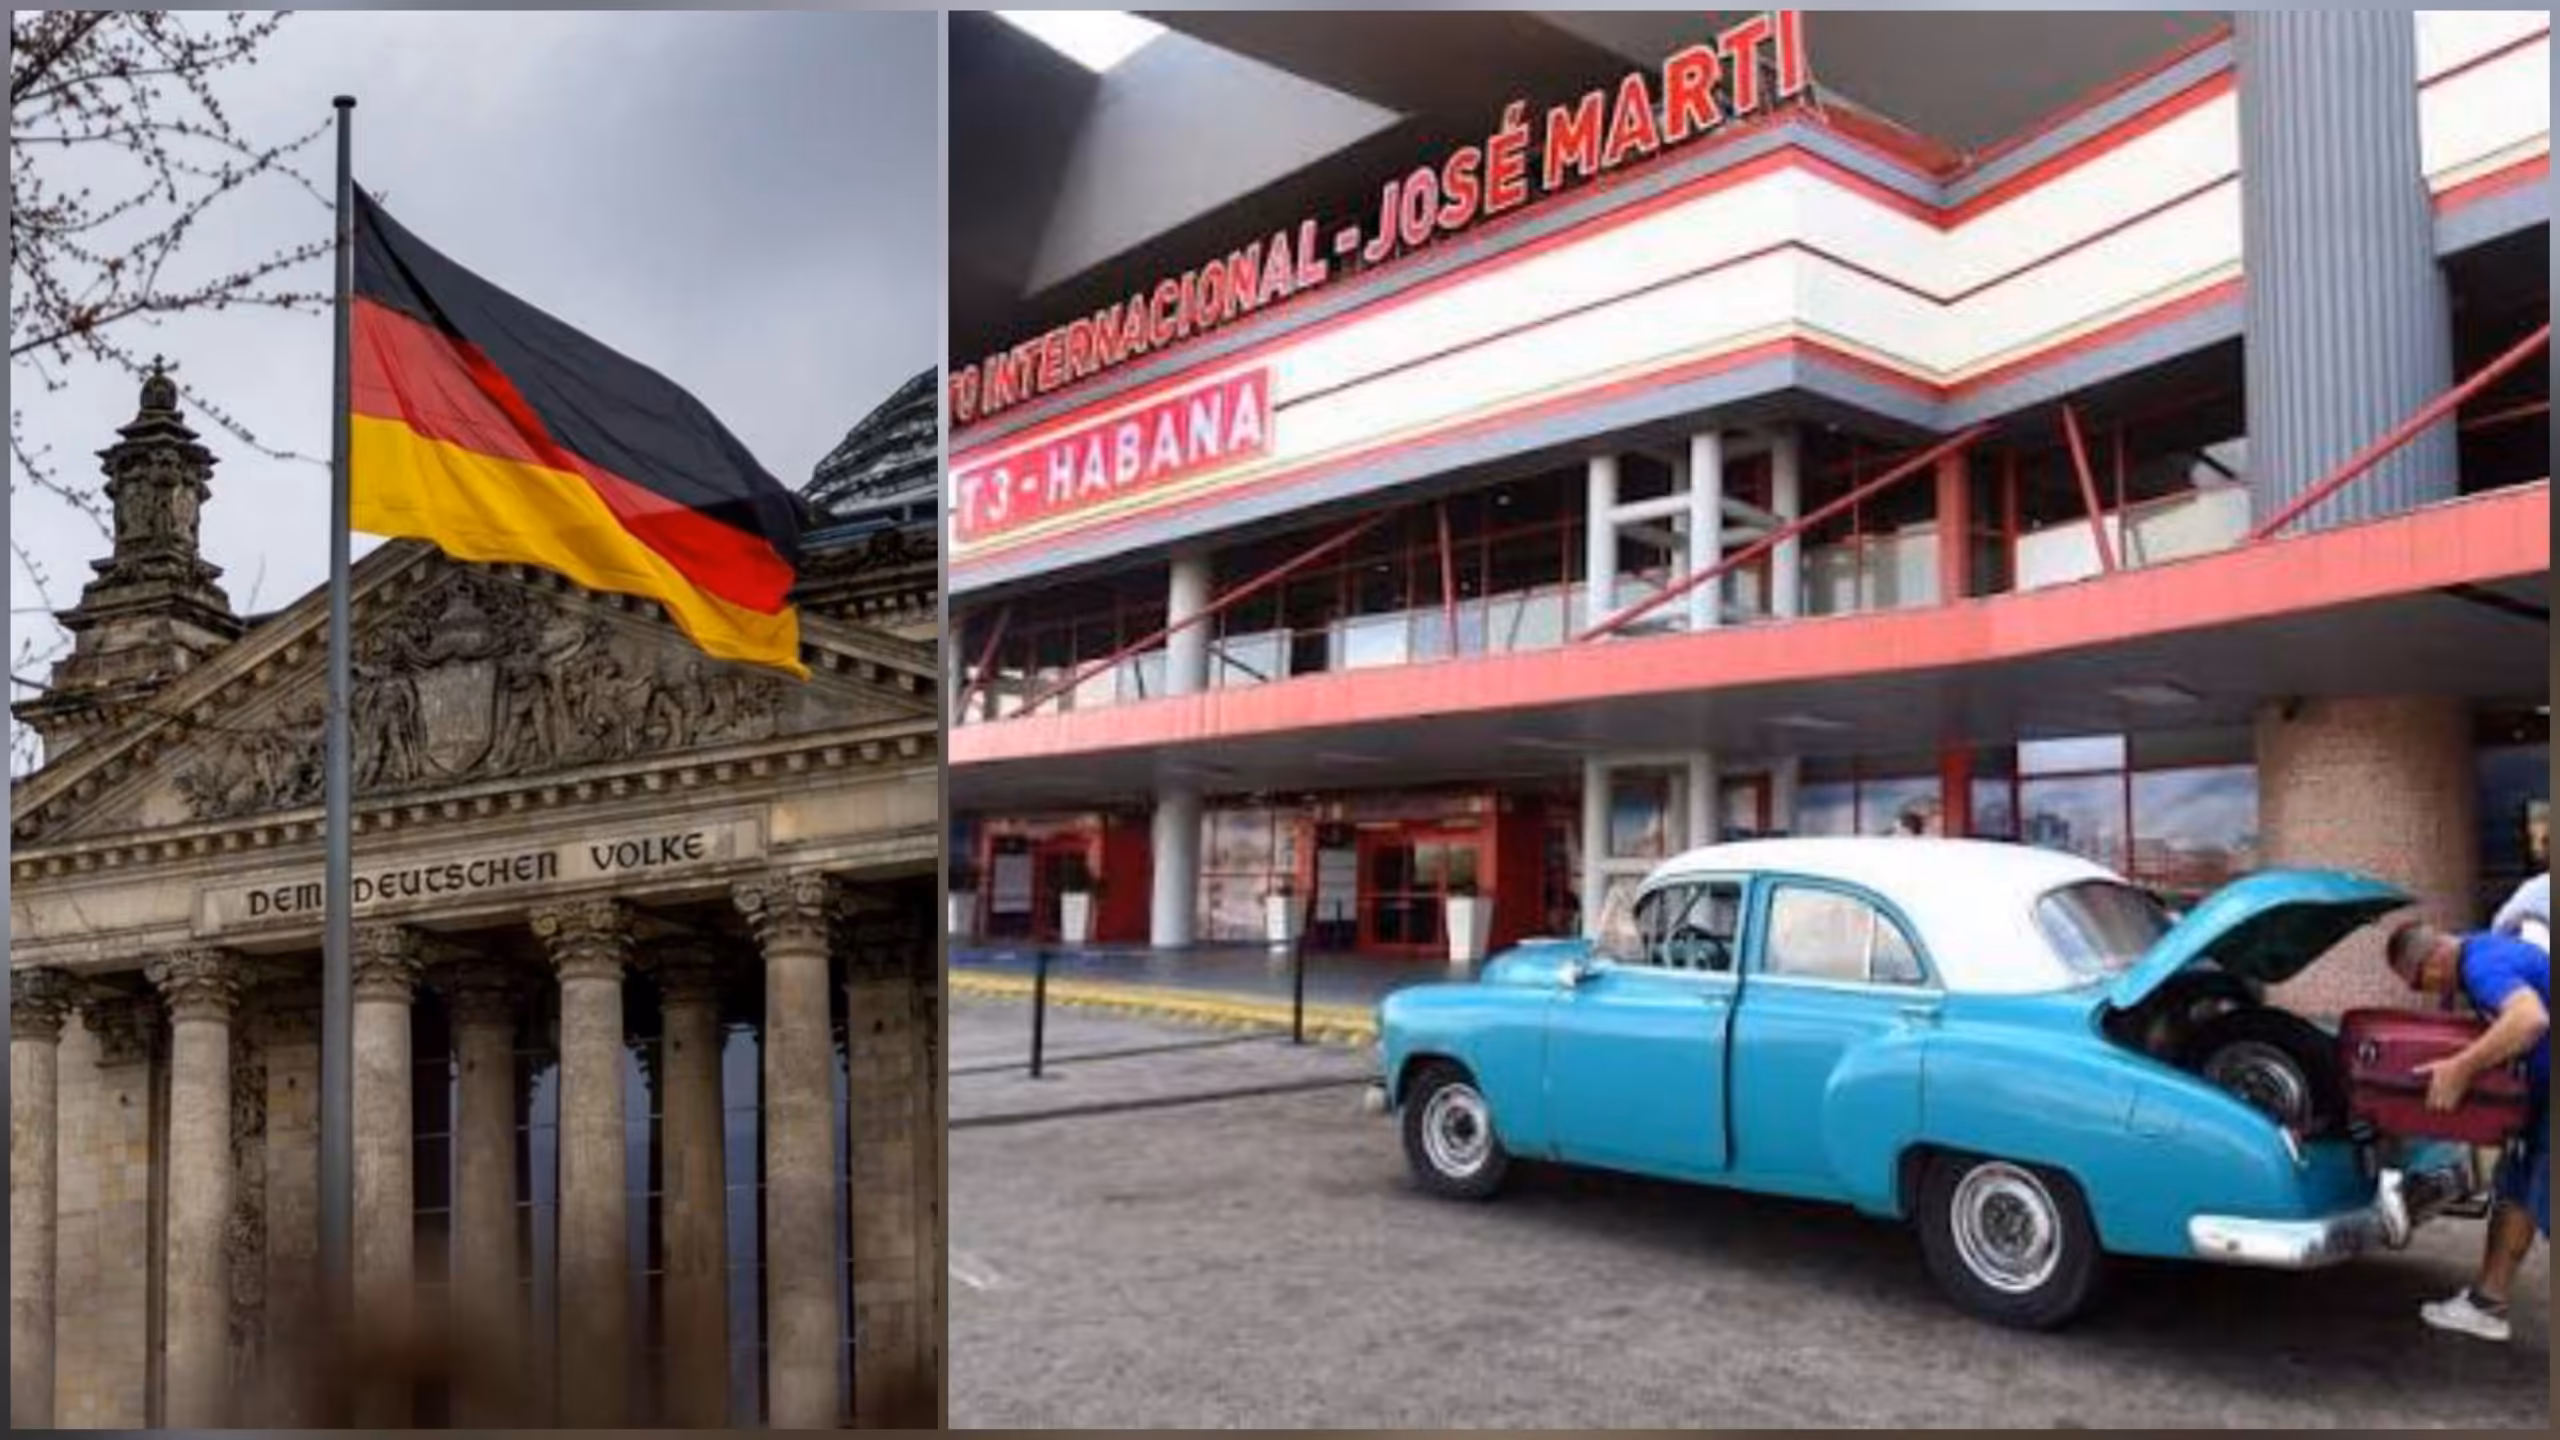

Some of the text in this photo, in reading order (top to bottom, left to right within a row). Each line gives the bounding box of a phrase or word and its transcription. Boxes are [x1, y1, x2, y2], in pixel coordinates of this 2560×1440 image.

[982, 219, 1328, 416] INTERNACIONAL
[1363, 99, 1529, 262] JOSÉ
[1047, 382, 1262, 503] HABANA
[248, 832, 705, 917] DEM DEUTSCHEN VOLKE
